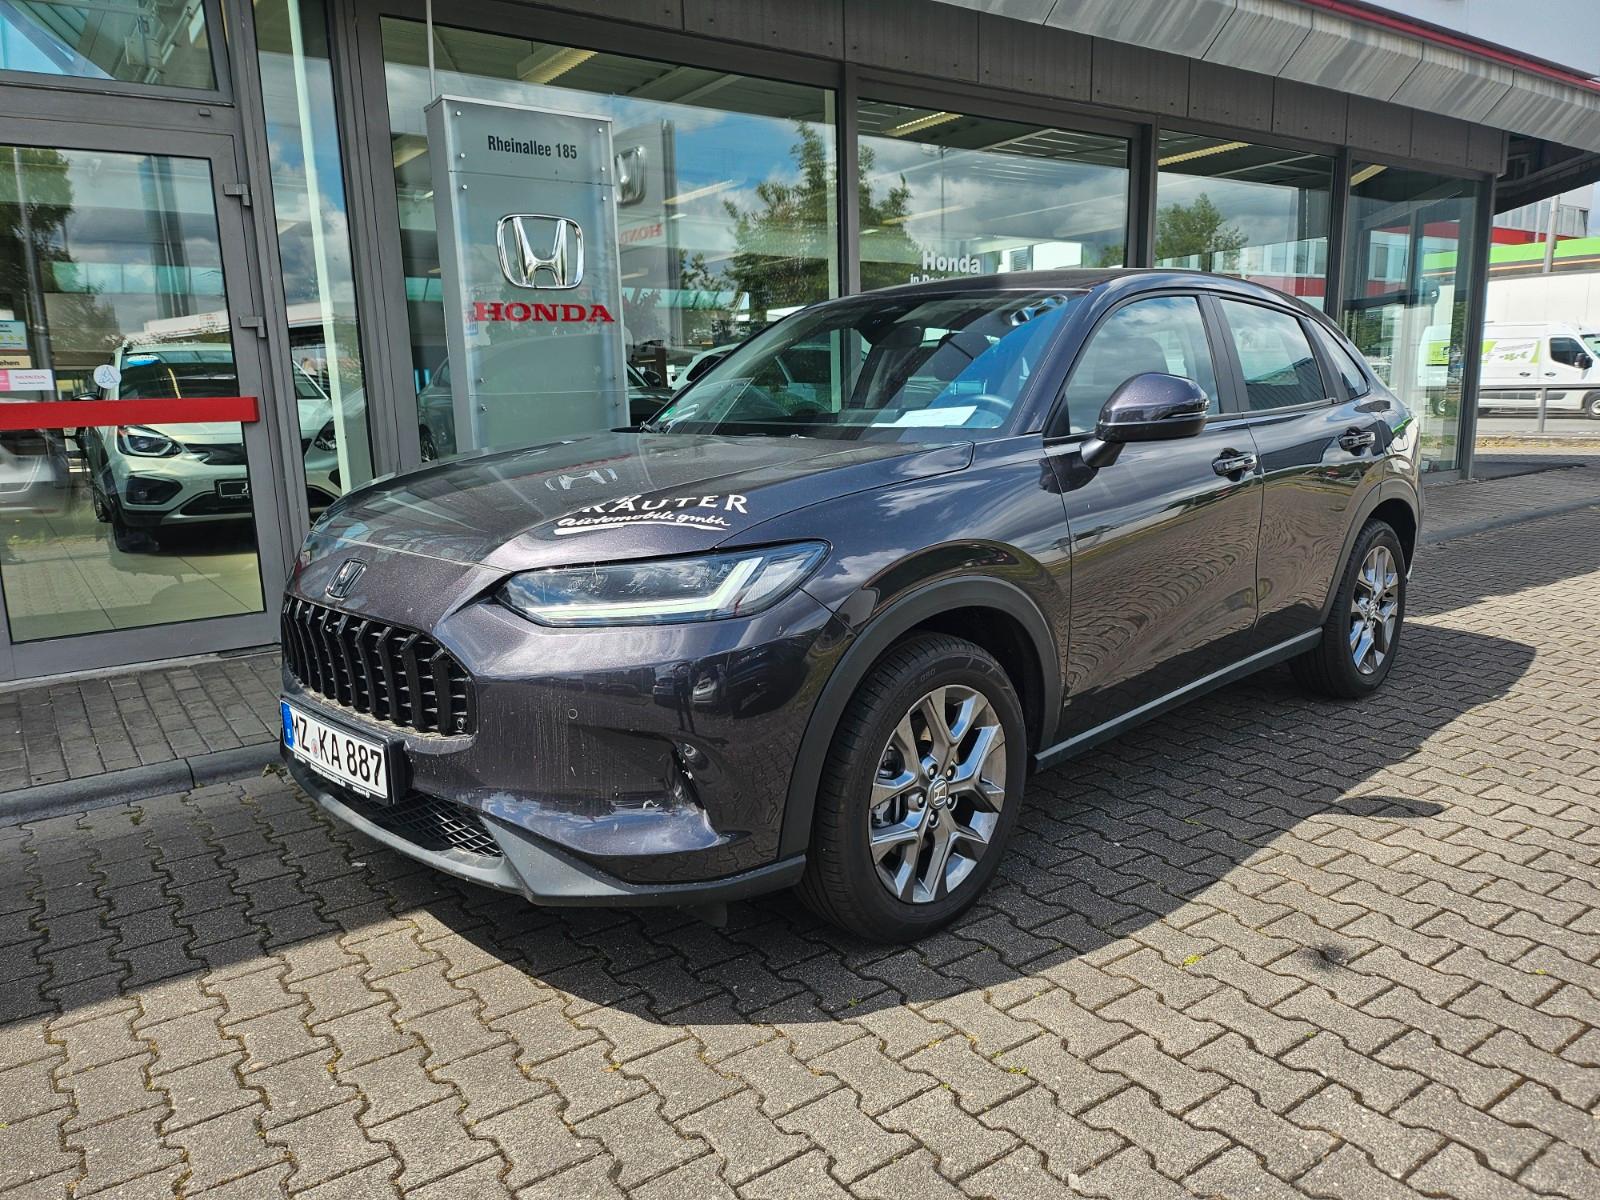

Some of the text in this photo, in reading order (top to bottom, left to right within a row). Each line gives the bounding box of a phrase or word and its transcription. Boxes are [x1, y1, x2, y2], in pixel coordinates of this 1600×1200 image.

[487, 135, 577, 159] Rheinallee 185
[922, 250, 981, 274] Honda
[473, 302, 615, 323] HONDA
[317, 726, 342, 771] KA
[345, 739, 383, 787] 887
